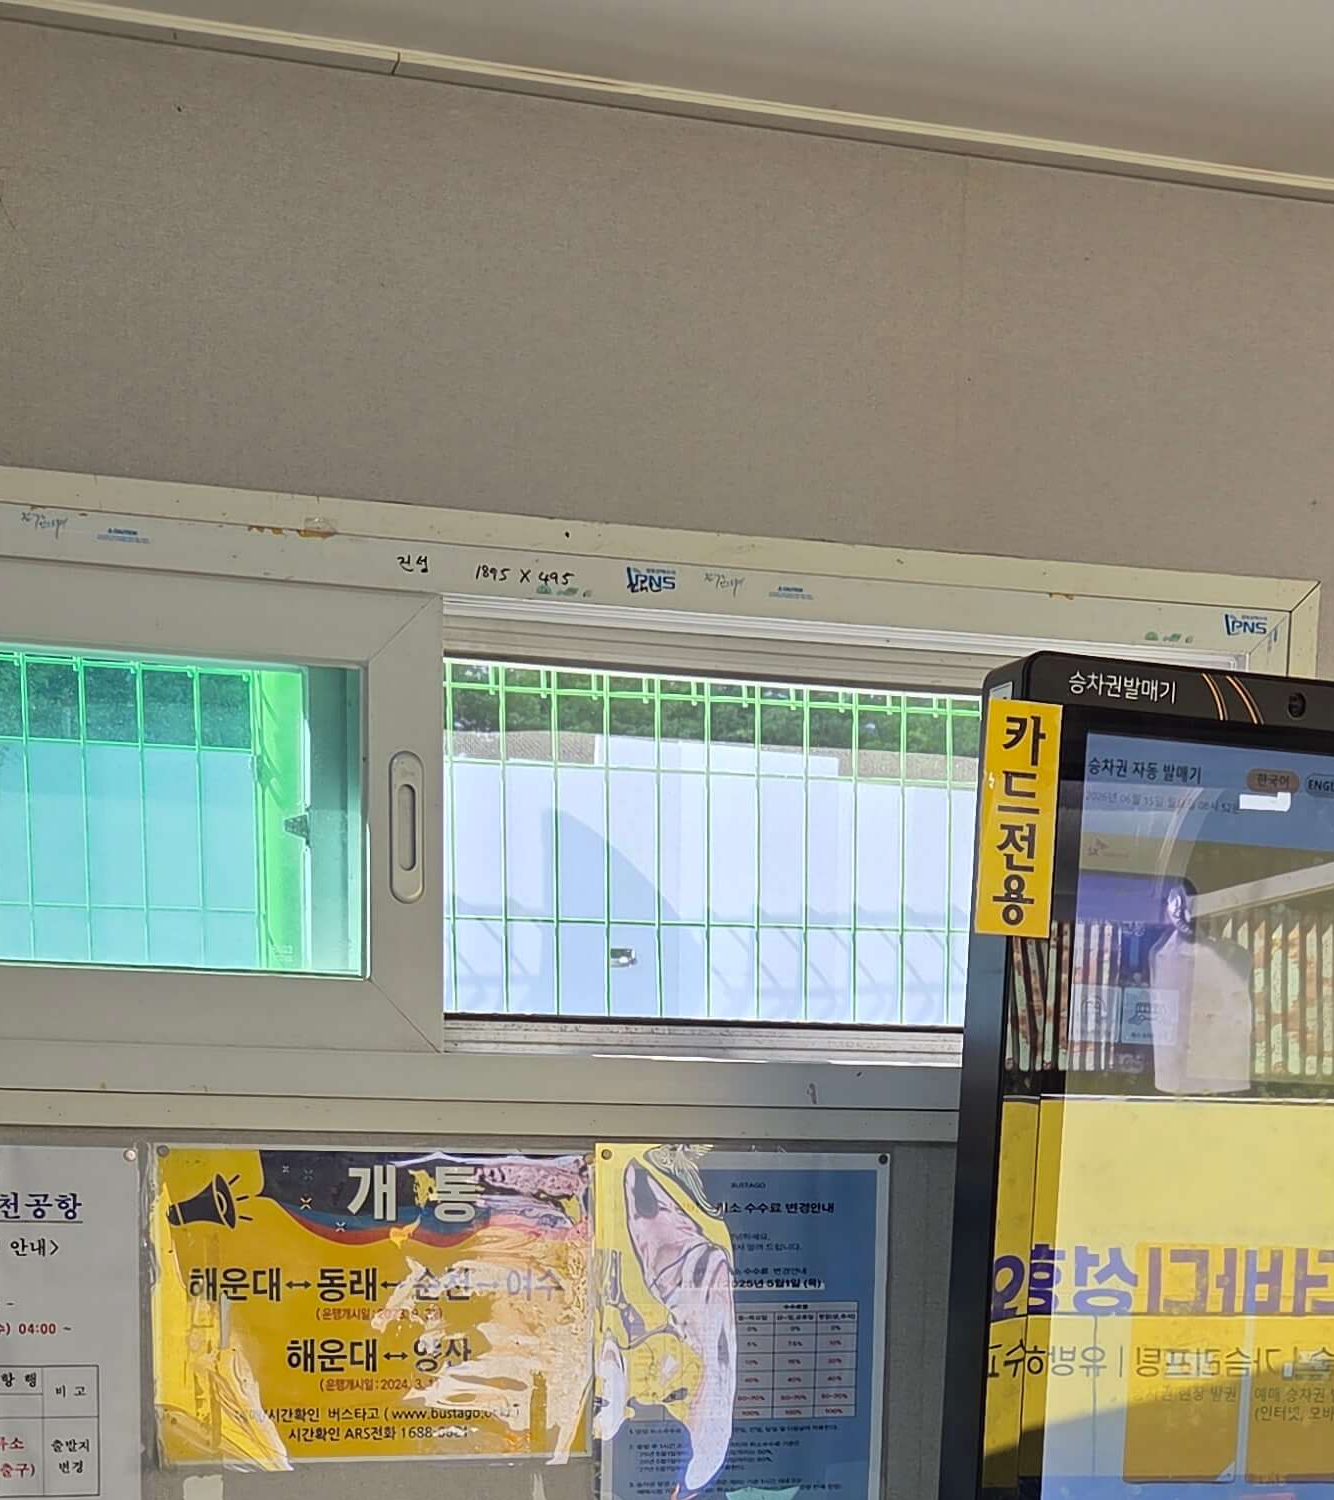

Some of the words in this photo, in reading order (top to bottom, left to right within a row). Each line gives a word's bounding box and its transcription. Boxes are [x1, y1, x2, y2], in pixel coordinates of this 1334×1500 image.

[475, 564, 510, 583] 1895
[537, 570, 576, 587] 495
[1227, 616, 1267, 635] PNS
[1068, 671, 1178, 704] 승차권발매기
[1088, 758, 1129, 778] 승차권
[1132, 761, 1158, 782] 자동
[1162, 763, 1203, 786] 발매기
[1257, 772, 1292, 788] 한국어
[991, 714, 1047, 927] 카드전용
[18, 1322, 57, 1335] 04:00
[1255, 1387, 1281, 1402] 예매
[1286, 1387, 1325, 1403] 승차권
[328, 1407, 379, 1422] 버스타고
[289, 1427, 340, 1441] 시간확인
[344, 1426, 395, 1440] ARS전화
[51, 1438, 90, 1453] 출발지
[58, 1460, 84, 1474] 변경
